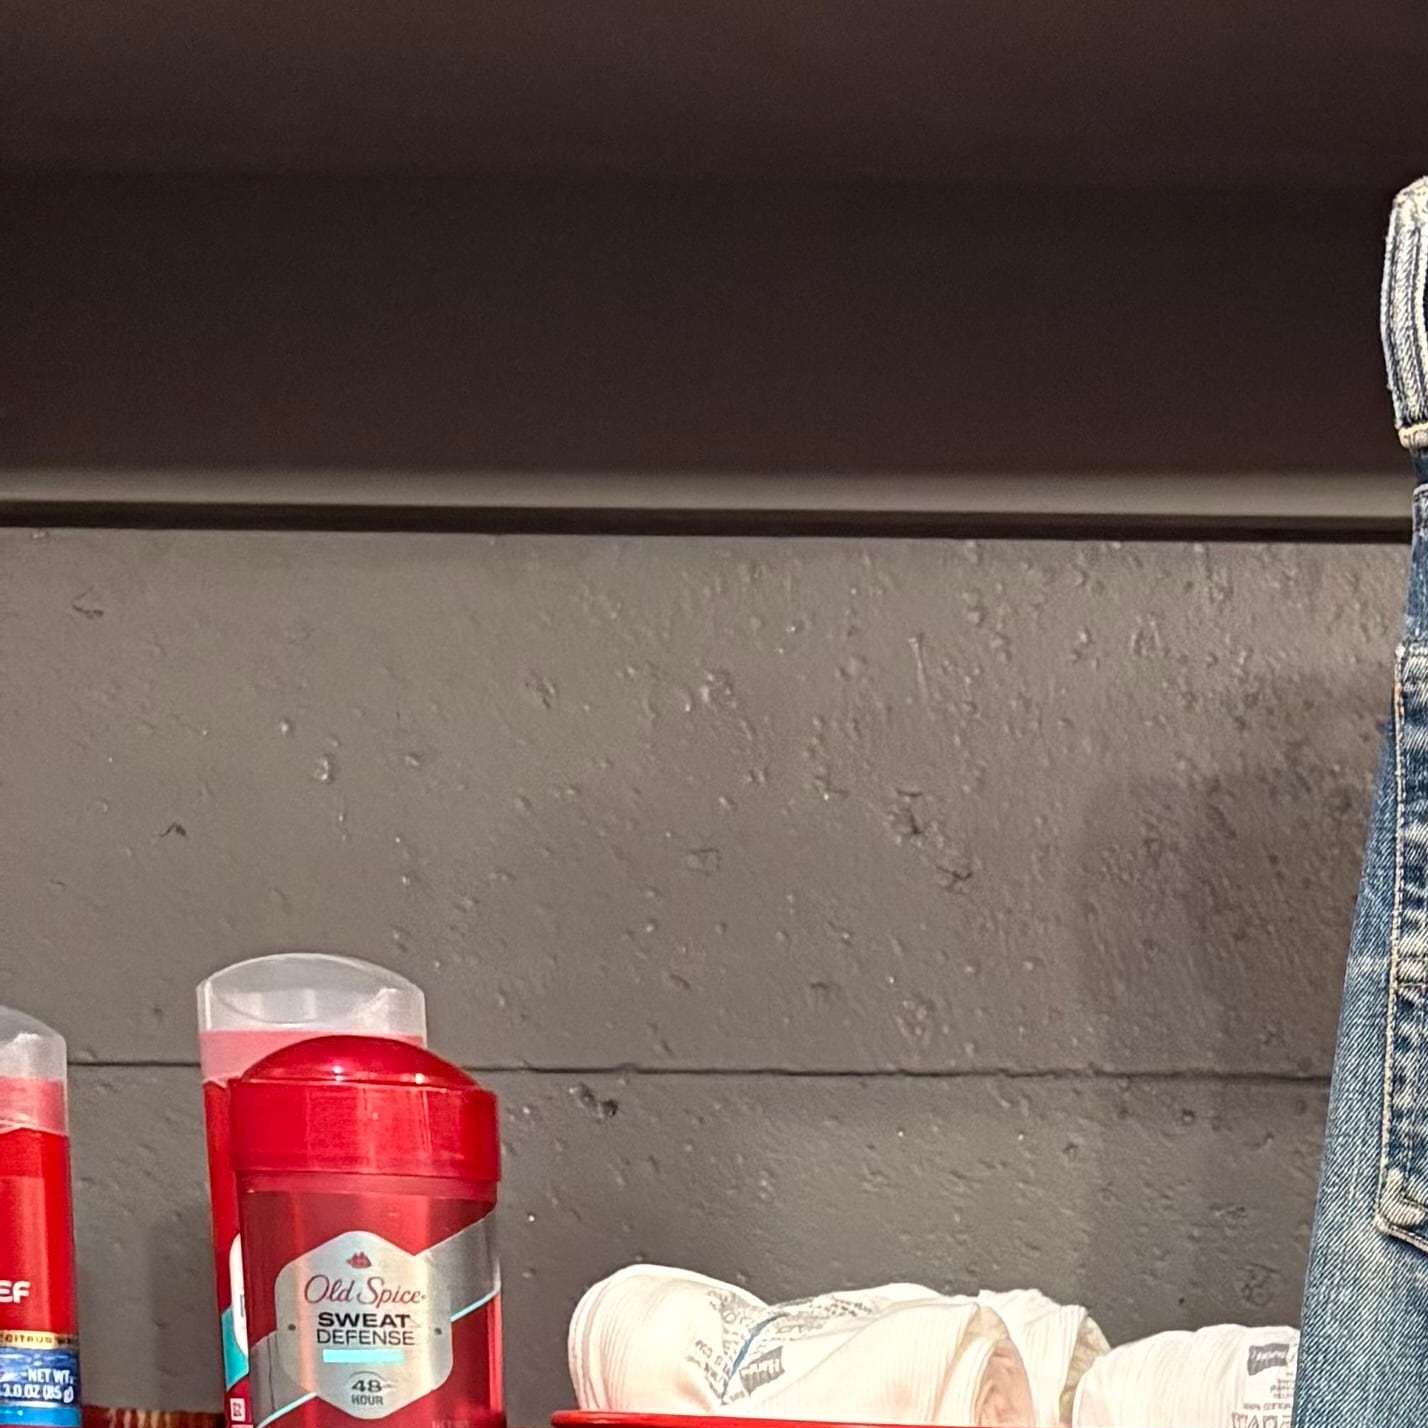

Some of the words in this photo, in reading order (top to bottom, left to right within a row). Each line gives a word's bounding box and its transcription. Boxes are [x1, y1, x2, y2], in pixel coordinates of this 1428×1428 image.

[304, 1274, 355, 1304] Old
[356, 1276, 422, 1308] Spice
[318, 1312, 410, 1328] SWEAT
[317, 1329, 415, 1345] DEFENSE
[28, 1368, 50, 1383] NET
[352, 1380, 383, 1392] 48
[352, 1395, 383, 1405] HOUR
